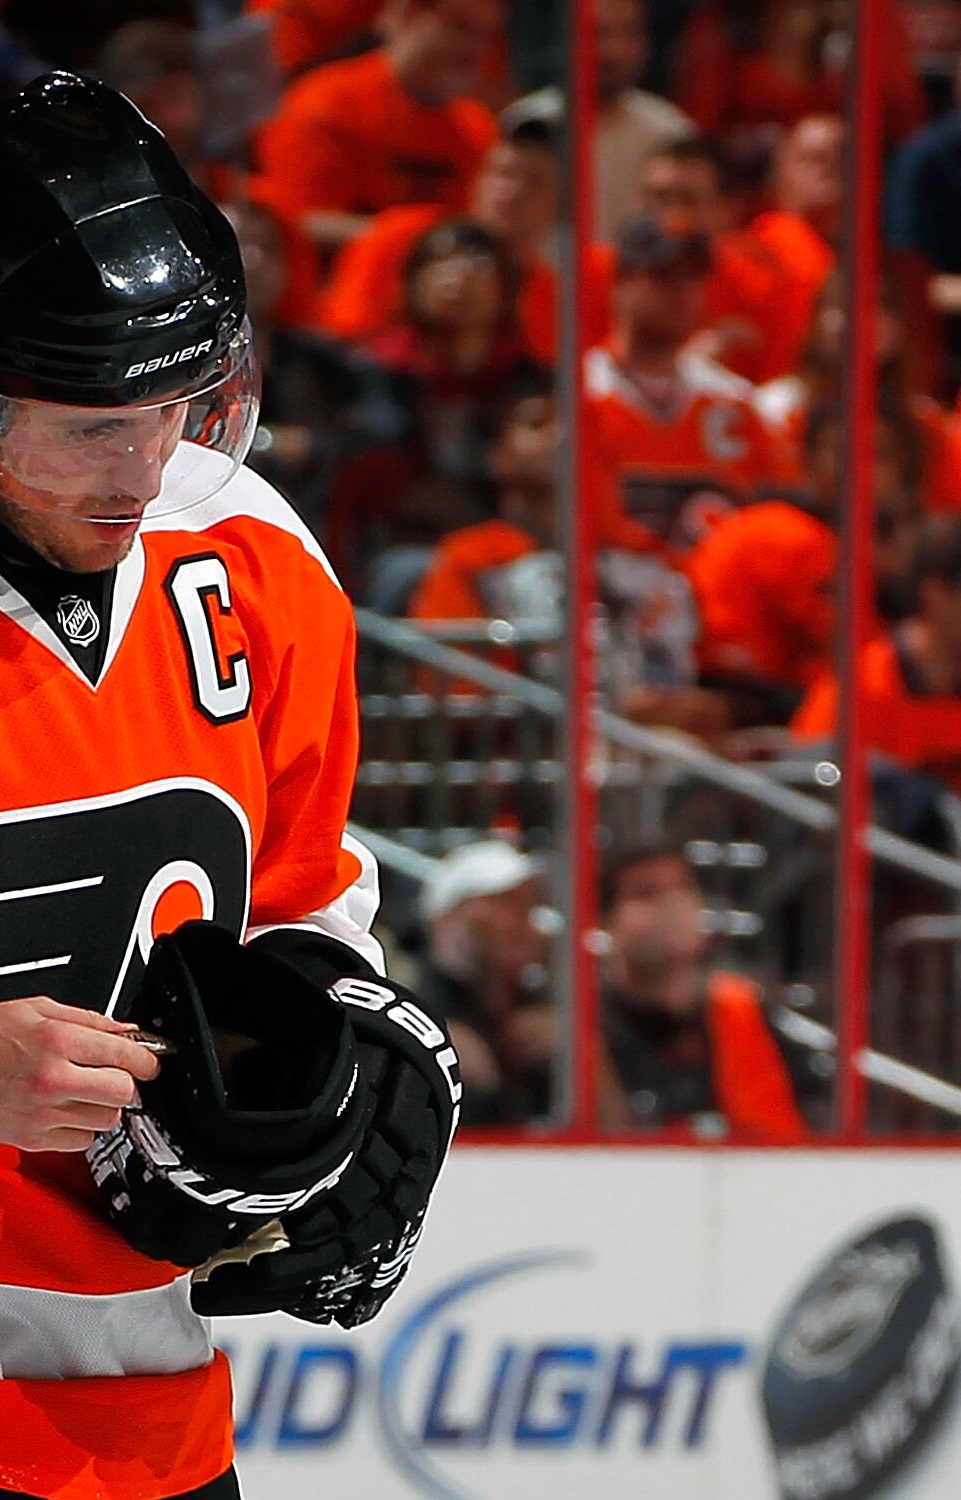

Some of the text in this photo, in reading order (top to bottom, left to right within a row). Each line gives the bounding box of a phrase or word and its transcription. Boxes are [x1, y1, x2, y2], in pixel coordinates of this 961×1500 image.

[124, 339, 214, 380] BAUER
[162, 551, 252, 725] C
[421, 1326, 748, 1450] LIGHT
